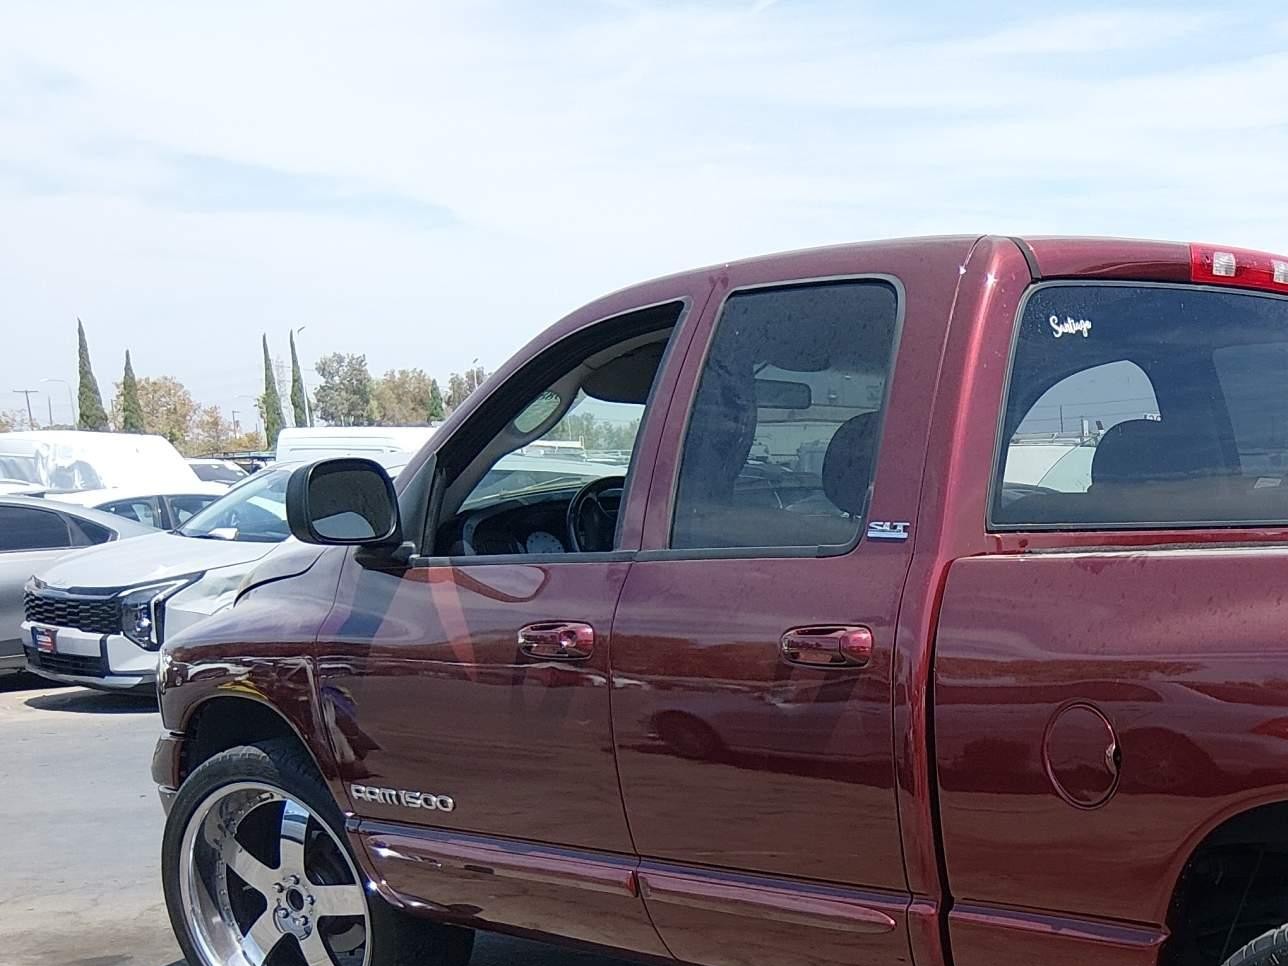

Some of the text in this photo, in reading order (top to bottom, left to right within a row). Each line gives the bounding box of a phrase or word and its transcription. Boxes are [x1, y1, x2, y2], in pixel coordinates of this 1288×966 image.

[868, 521, 910, 534] SLT
[351, 783, 454, 812] RAM 1500
